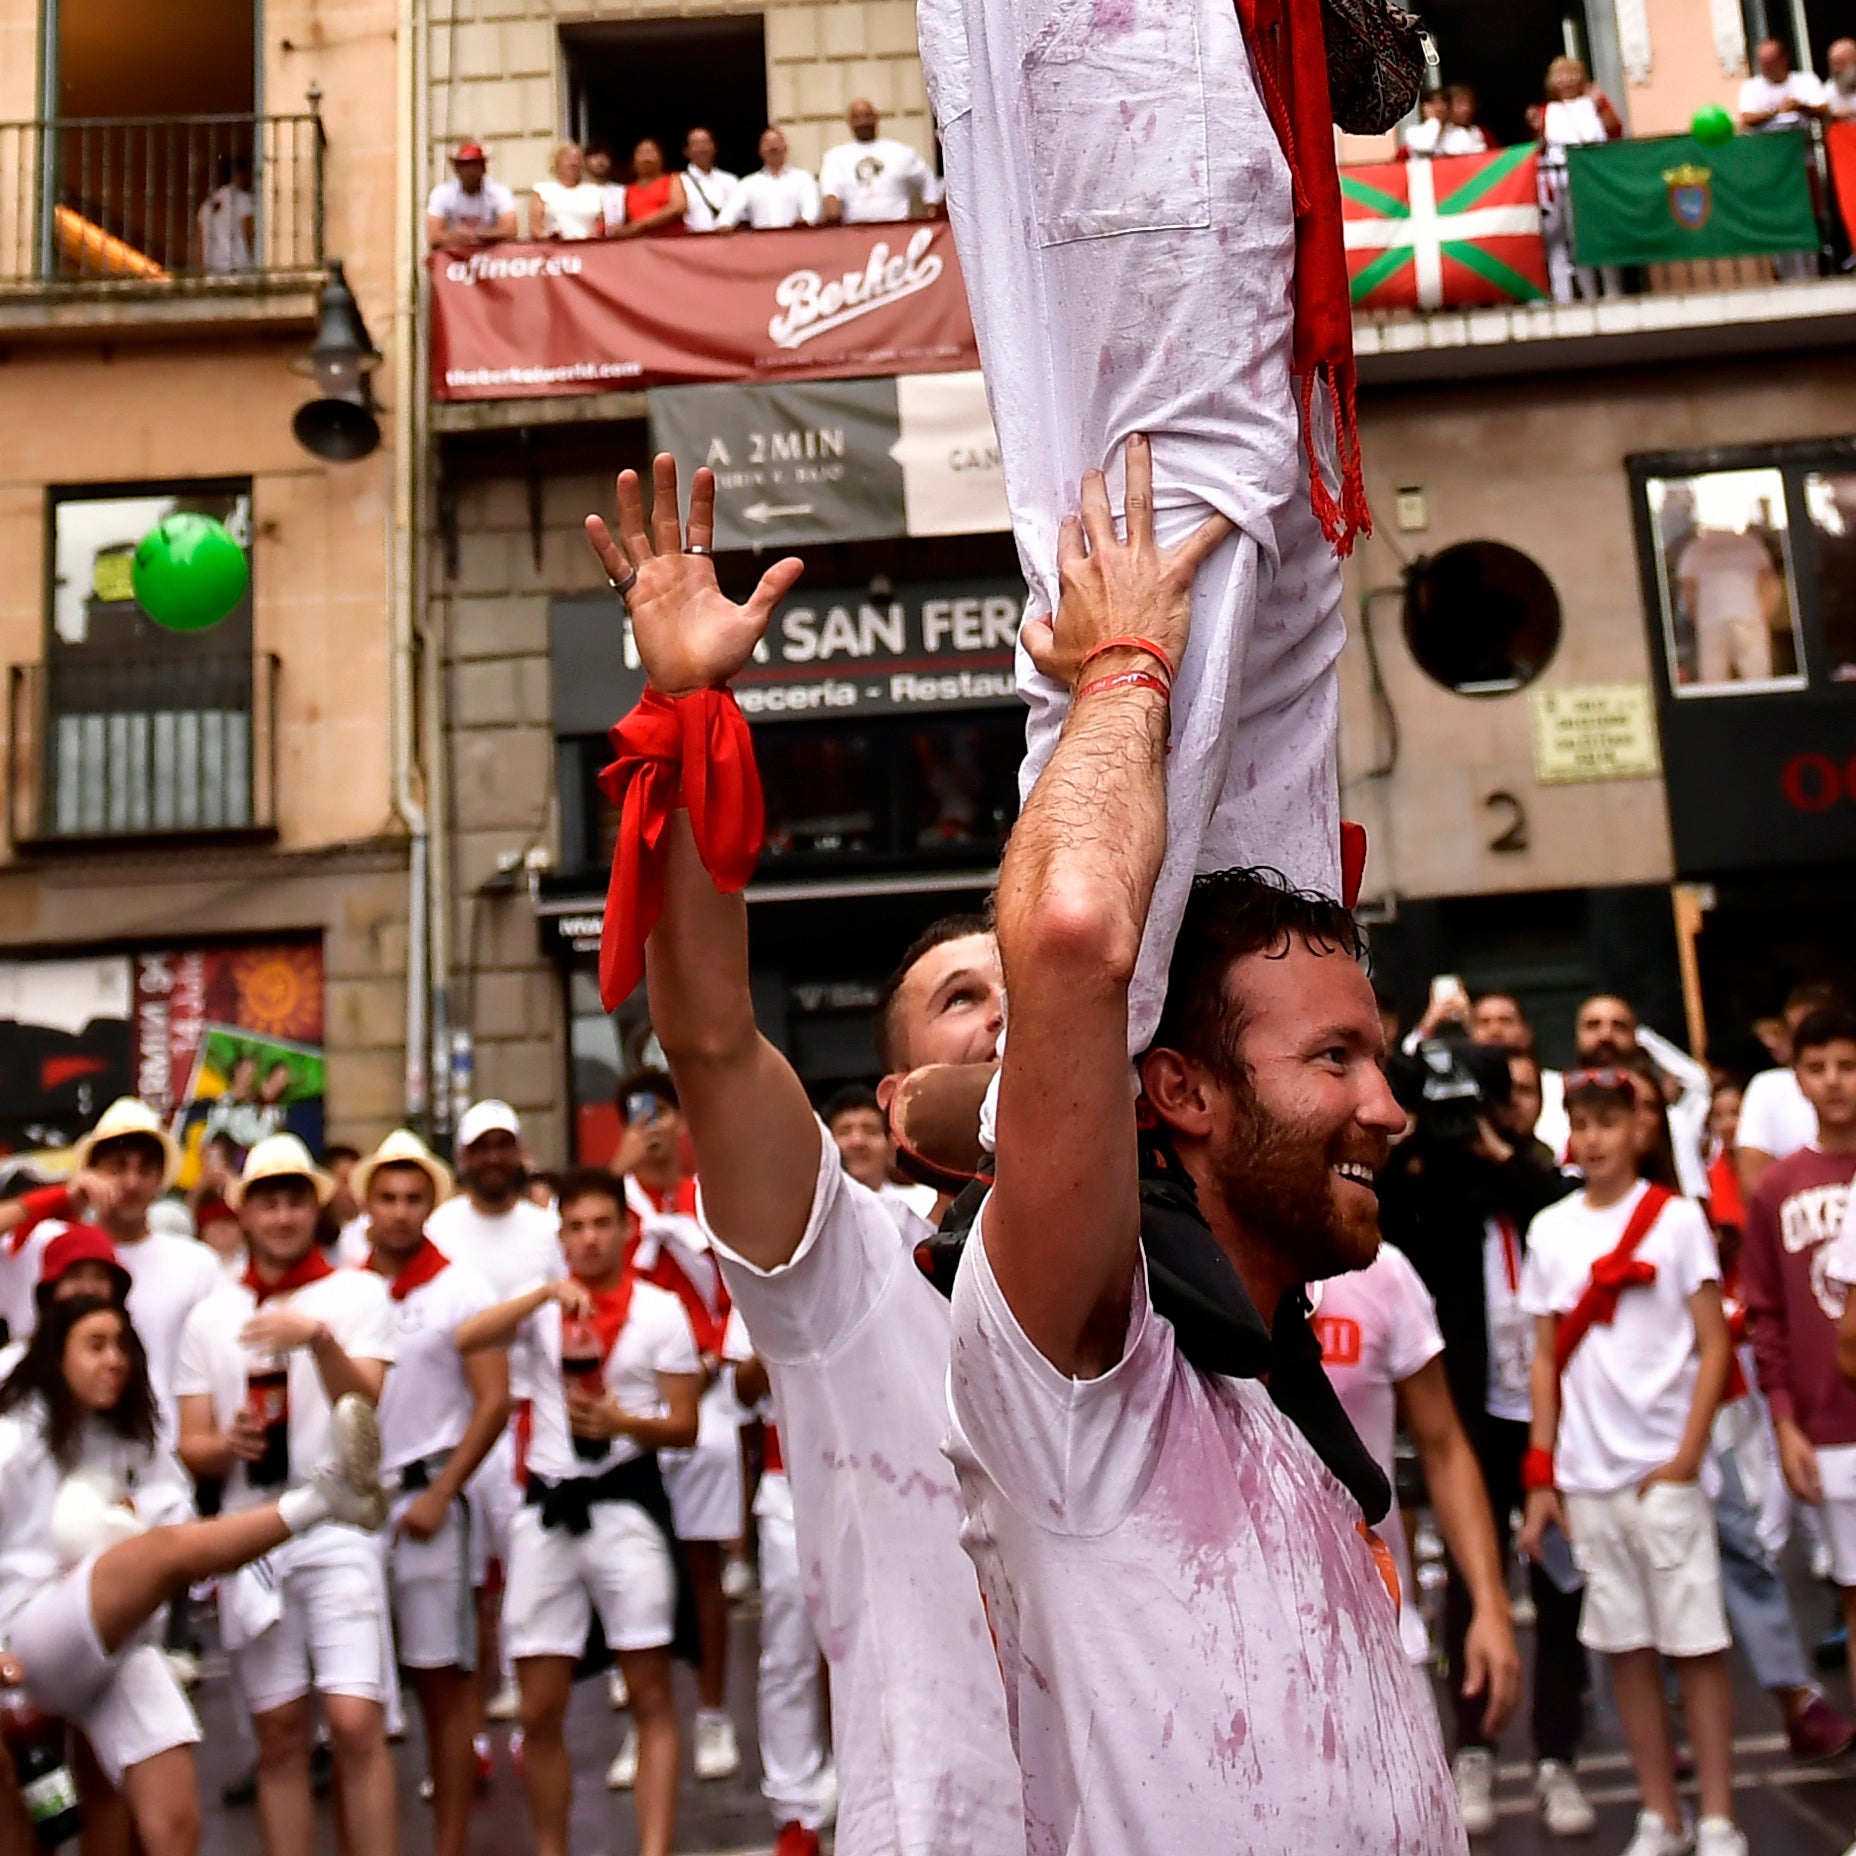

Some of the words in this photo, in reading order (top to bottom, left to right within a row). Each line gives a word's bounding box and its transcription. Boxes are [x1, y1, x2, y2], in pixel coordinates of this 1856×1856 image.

[767, 225, 944, 350] Berkel
[705, 436, 731, 468] A
[747, 426, 847, 465] 2MIN
[781, 600, 907, 664] SAN
[921, 596, 1022, 655] FER
[889, 669, 1016, 703] Restau
[1484, 790, 1530, 853] 2
